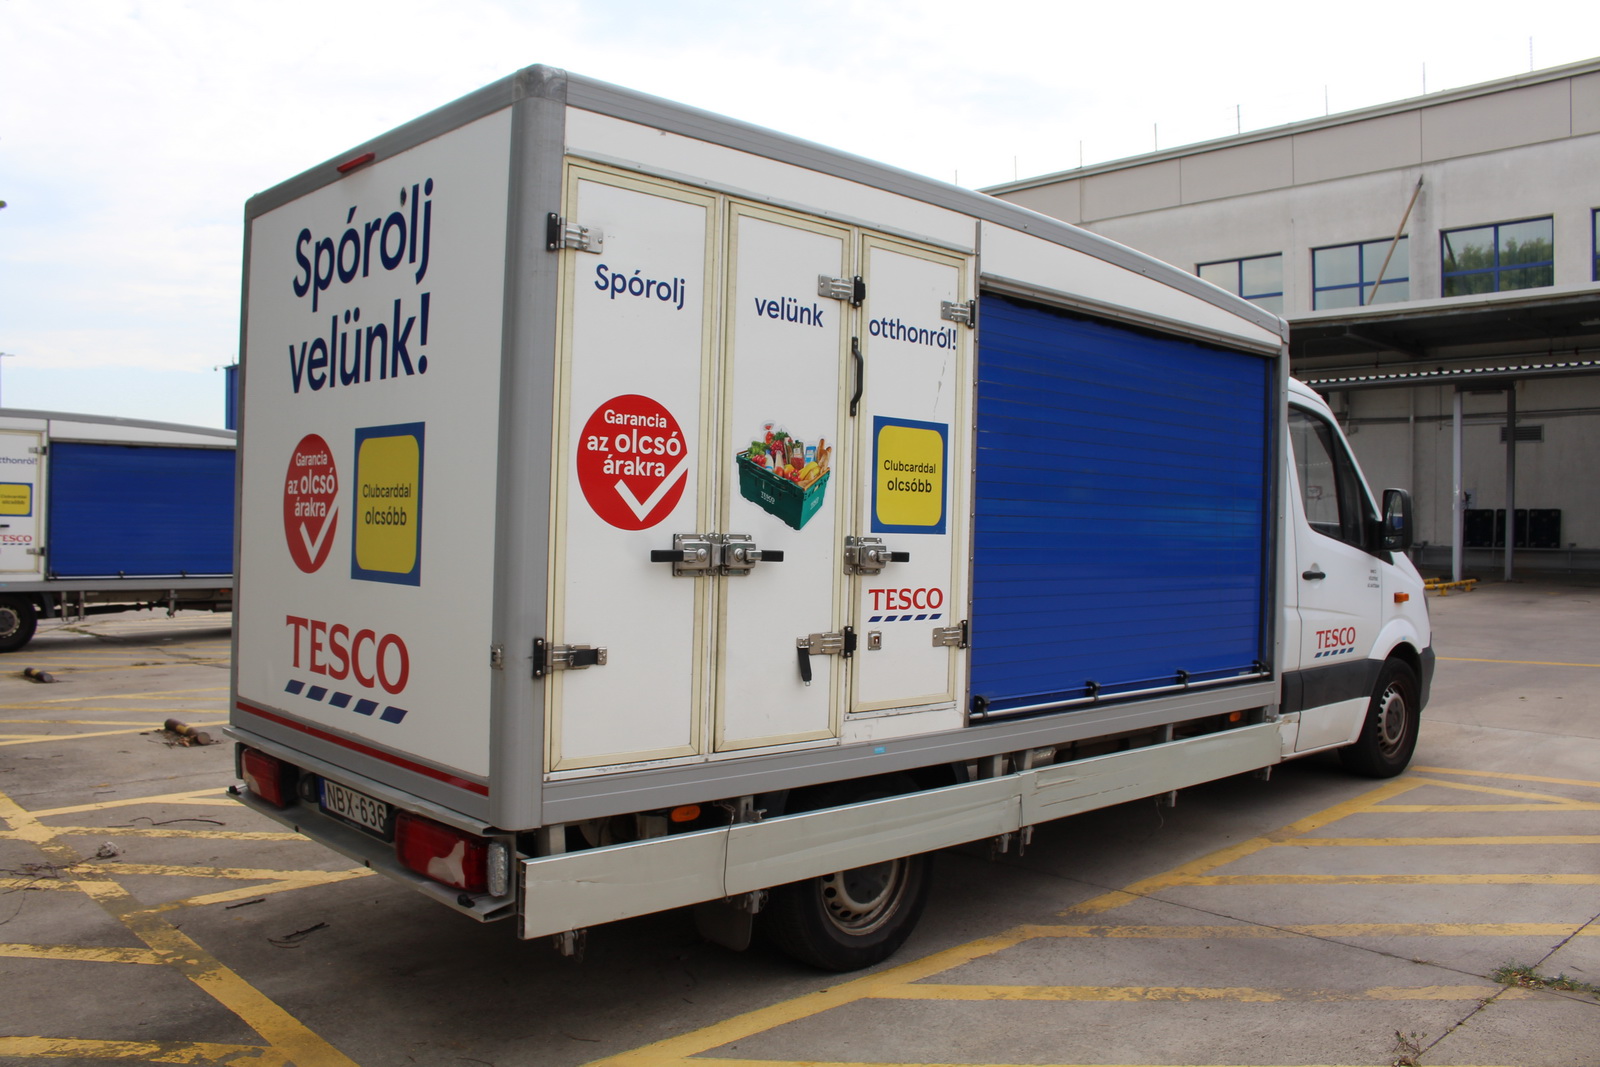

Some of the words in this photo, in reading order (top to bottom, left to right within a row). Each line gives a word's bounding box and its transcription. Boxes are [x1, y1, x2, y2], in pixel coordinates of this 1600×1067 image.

[293, 178, 433, 313] Spórolj
[595, 264, 685, 310] Spórolj
[755, 296, 824, 327] velünk
[869, 318, 957, 349] otthonról!
[289, 292, 430, 393] velünk!
[604, 409, 667, 428] Garancia
[587, 435, 609, 451] az
[615, 429, 681, 456] olcsó
[296, 451, 328, 467] Garancia
[603, 454, 665, 477] árakra
[884, 459, 936, 474] Clubcarddal
[287, 480, 299, 494] az
[300, 467, 335, 494] olcsó
[362, 483, 412, 498] Clubcarddal
[887, 476, 932, 493] olcsóbb
[295, 497, 326, 517] árakra
[365, 506, 407, 526] olcsóbb
[868, 588, 943, 610] TESCO
[1316, 626, 1356, 649] TESCO
[286, 615, 410, 695] TESCO
[326, 783, 386, 831] NBX-636
